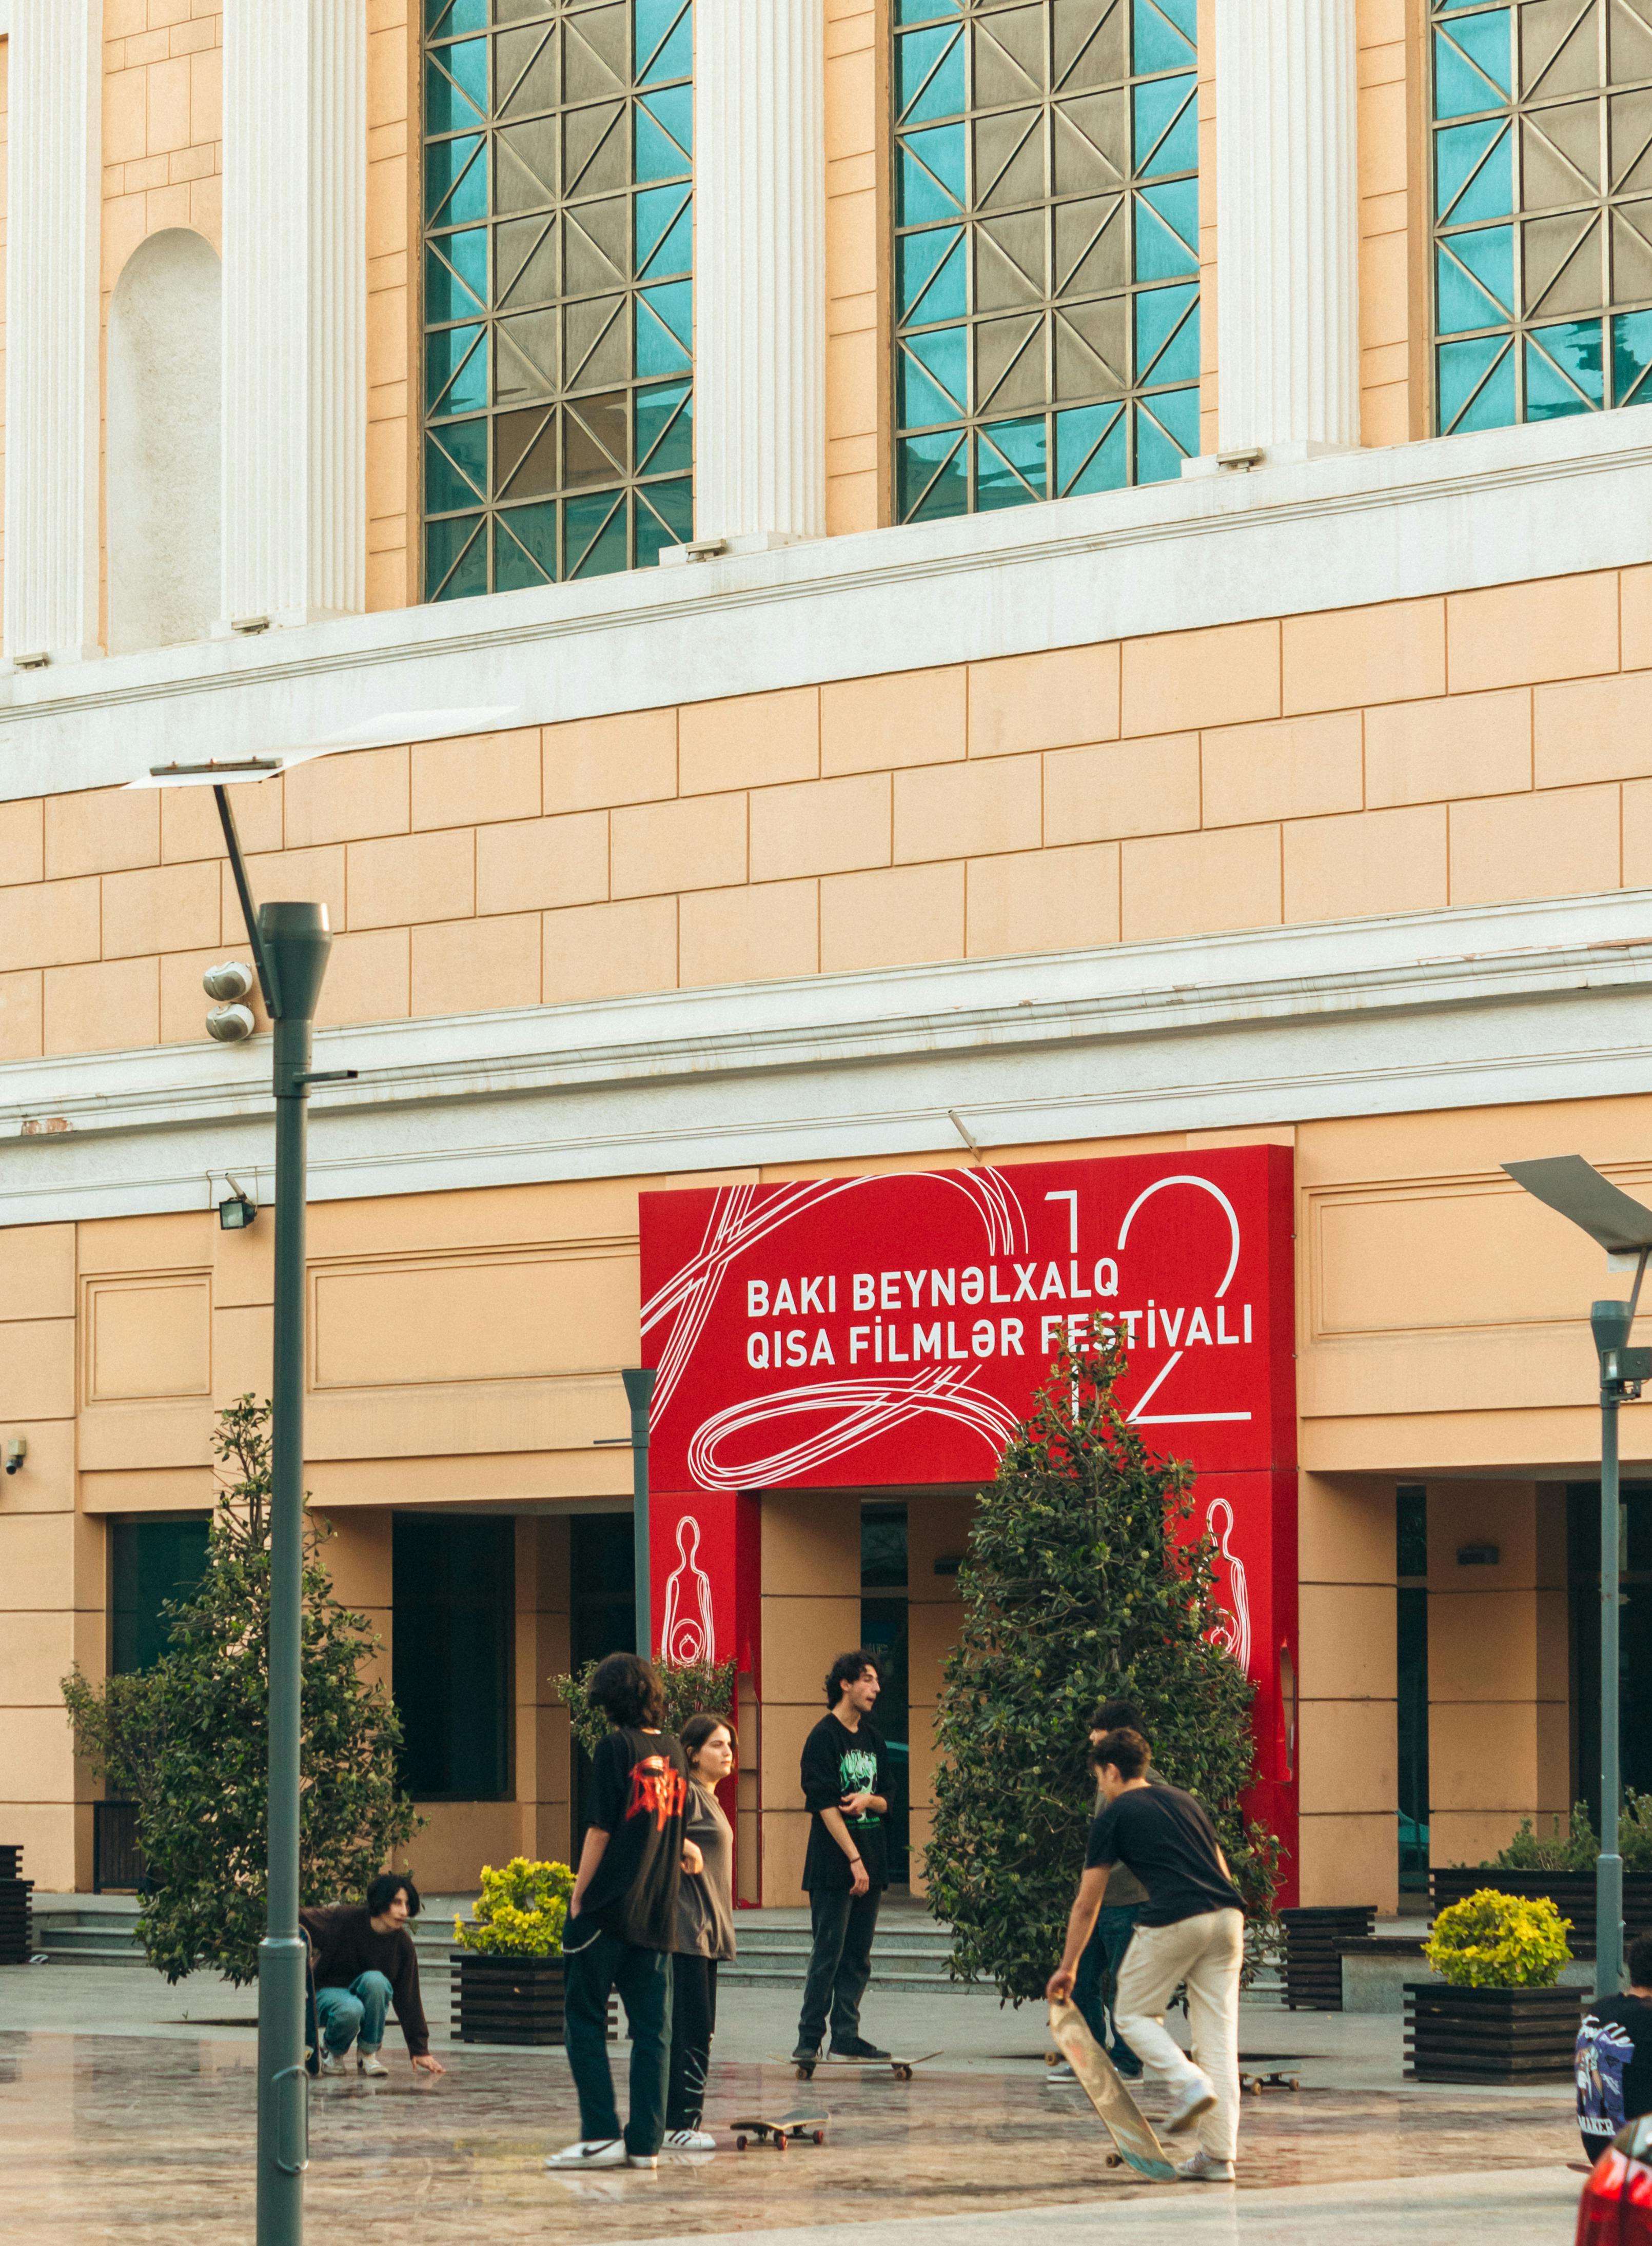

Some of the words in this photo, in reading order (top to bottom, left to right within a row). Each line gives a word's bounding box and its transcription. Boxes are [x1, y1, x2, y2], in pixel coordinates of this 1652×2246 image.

[747, 1275, 836, 1317] BAKI
[853, 1257, 1119, 1312] BEYNƏLXALQ
[746, 1328, 836, 1370] QISA
[849, 1315, 1026, 1364] FİLMLƏR
[1040, 1299, 1252, 1354] FESTİVALI
